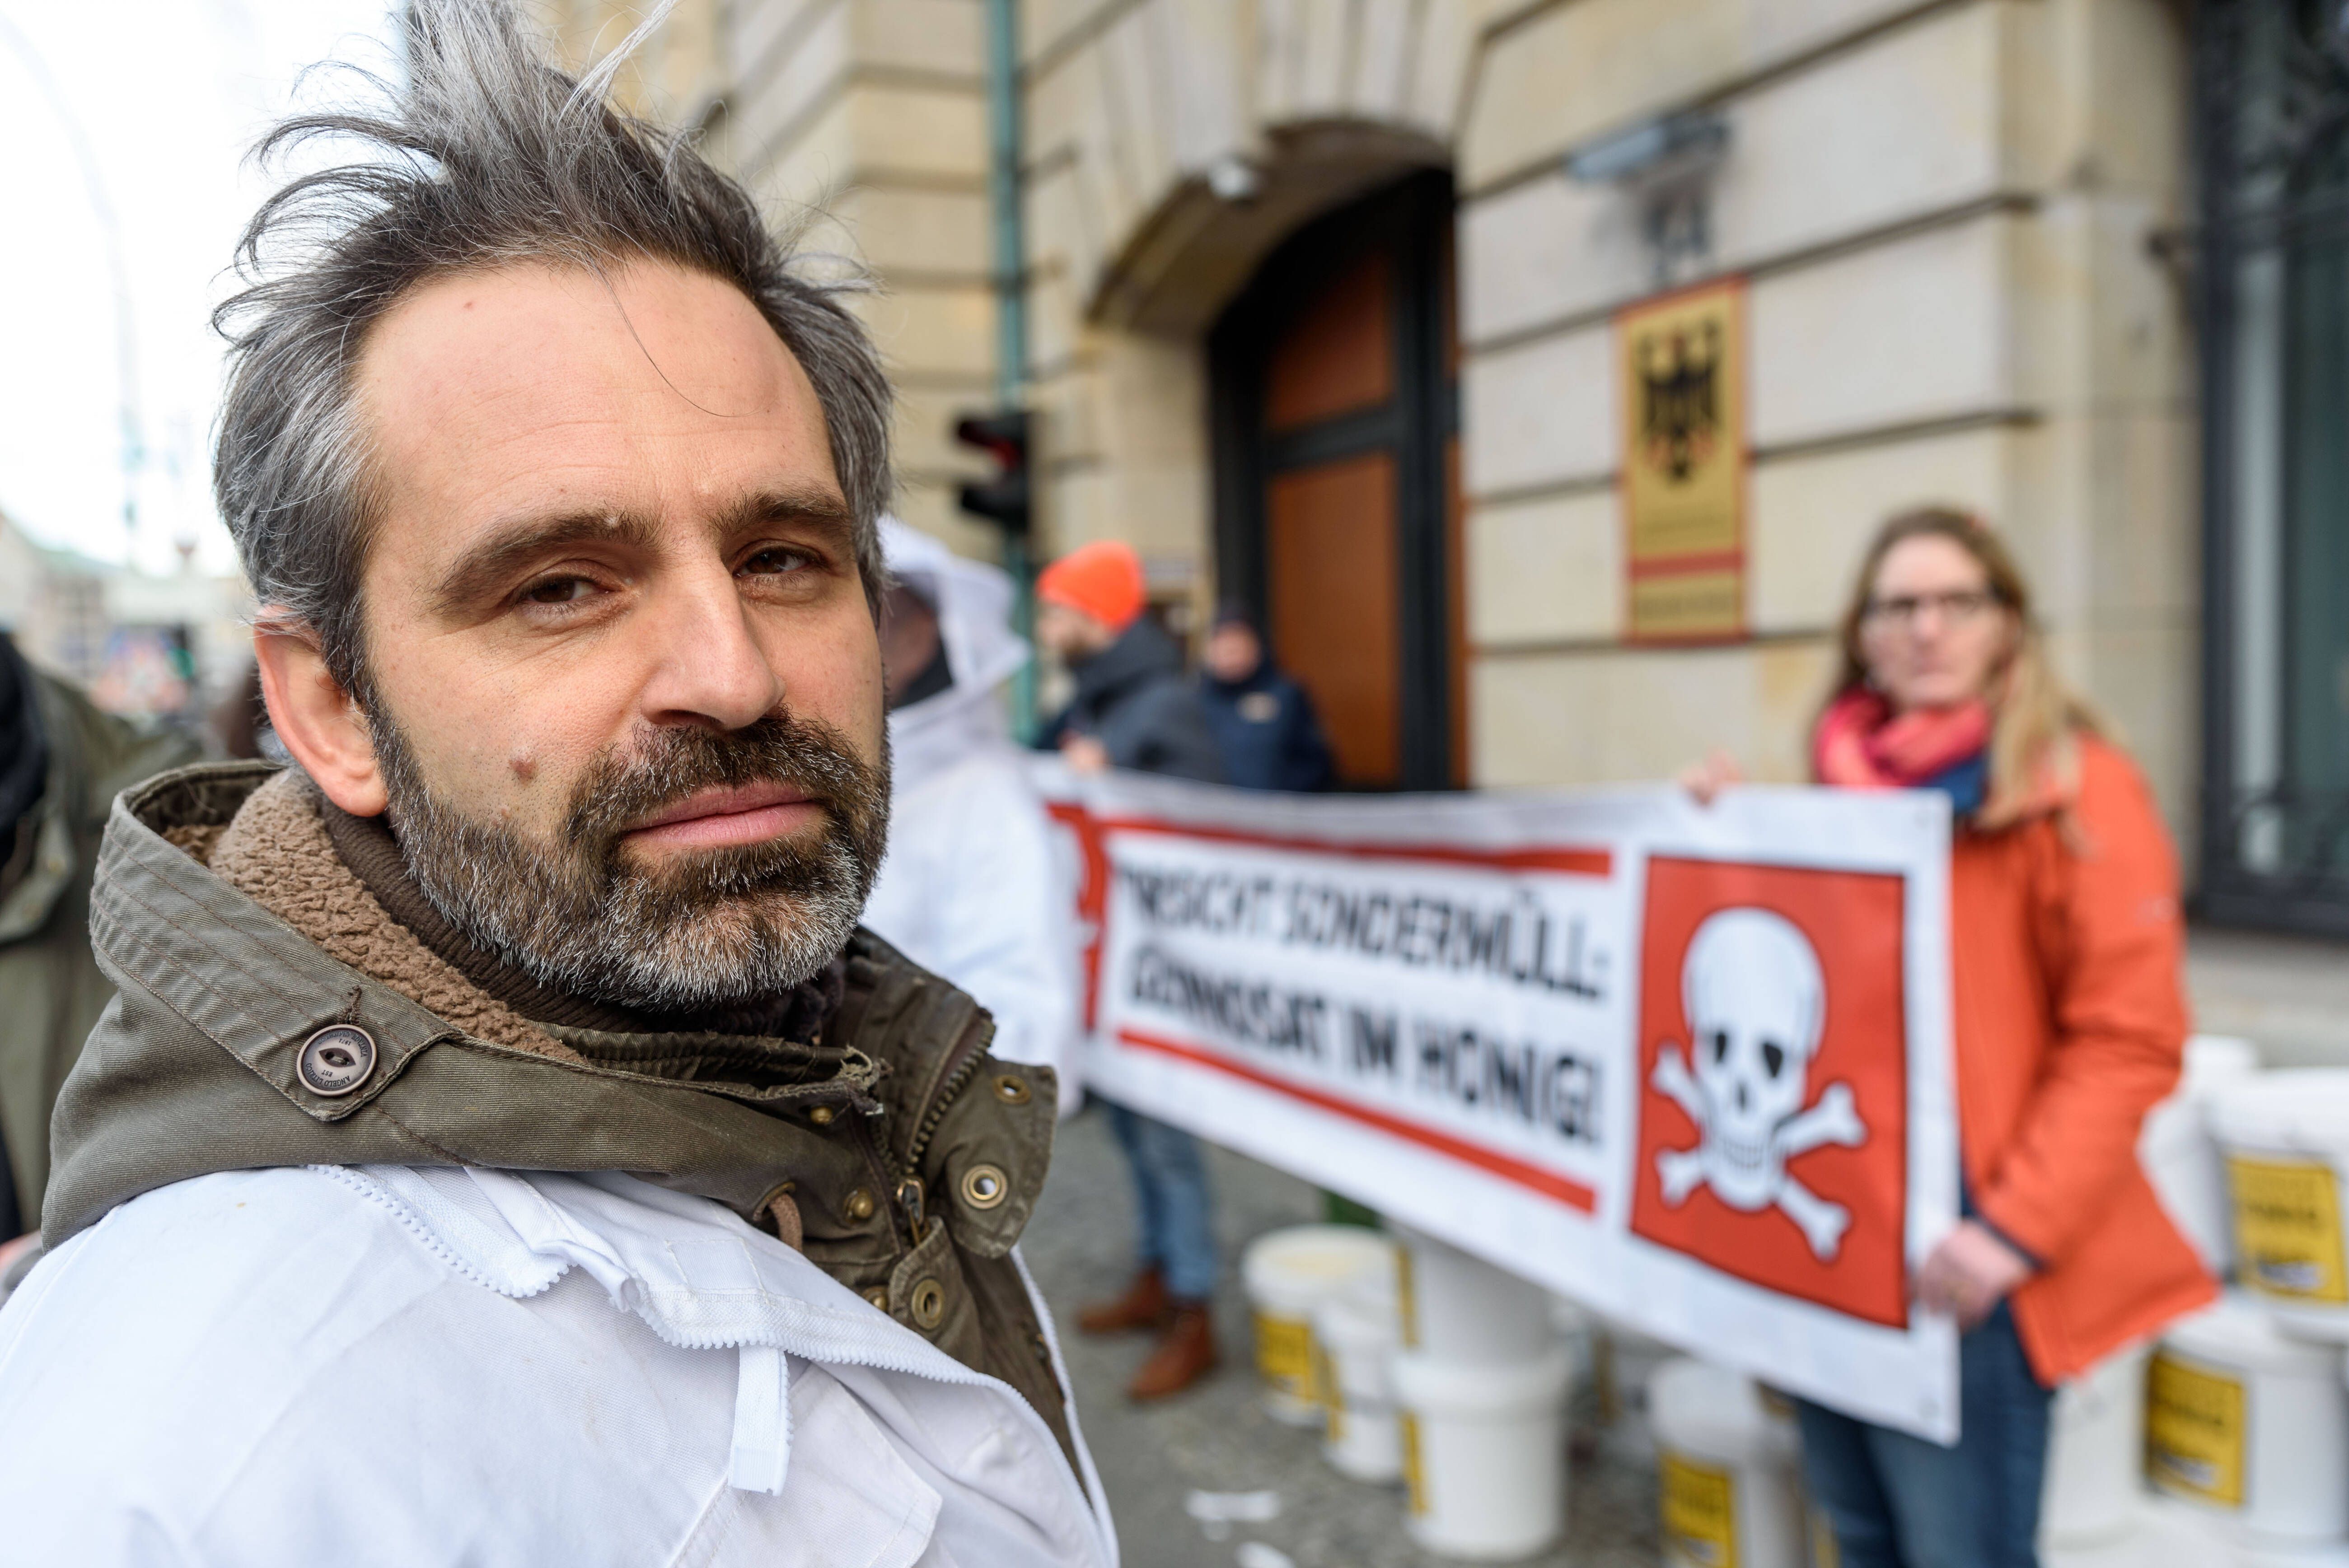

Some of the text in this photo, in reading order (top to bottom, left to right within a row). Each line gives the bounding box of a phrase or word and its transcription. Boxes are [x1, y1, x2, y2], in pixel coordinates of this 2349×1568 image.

[1280, 881, 1608, 998] SONDERMÜLL:
[351, 1034, 368, 1057] VINTAGE
[305, 1063, 350, 1087] ANGELO LITRICO
